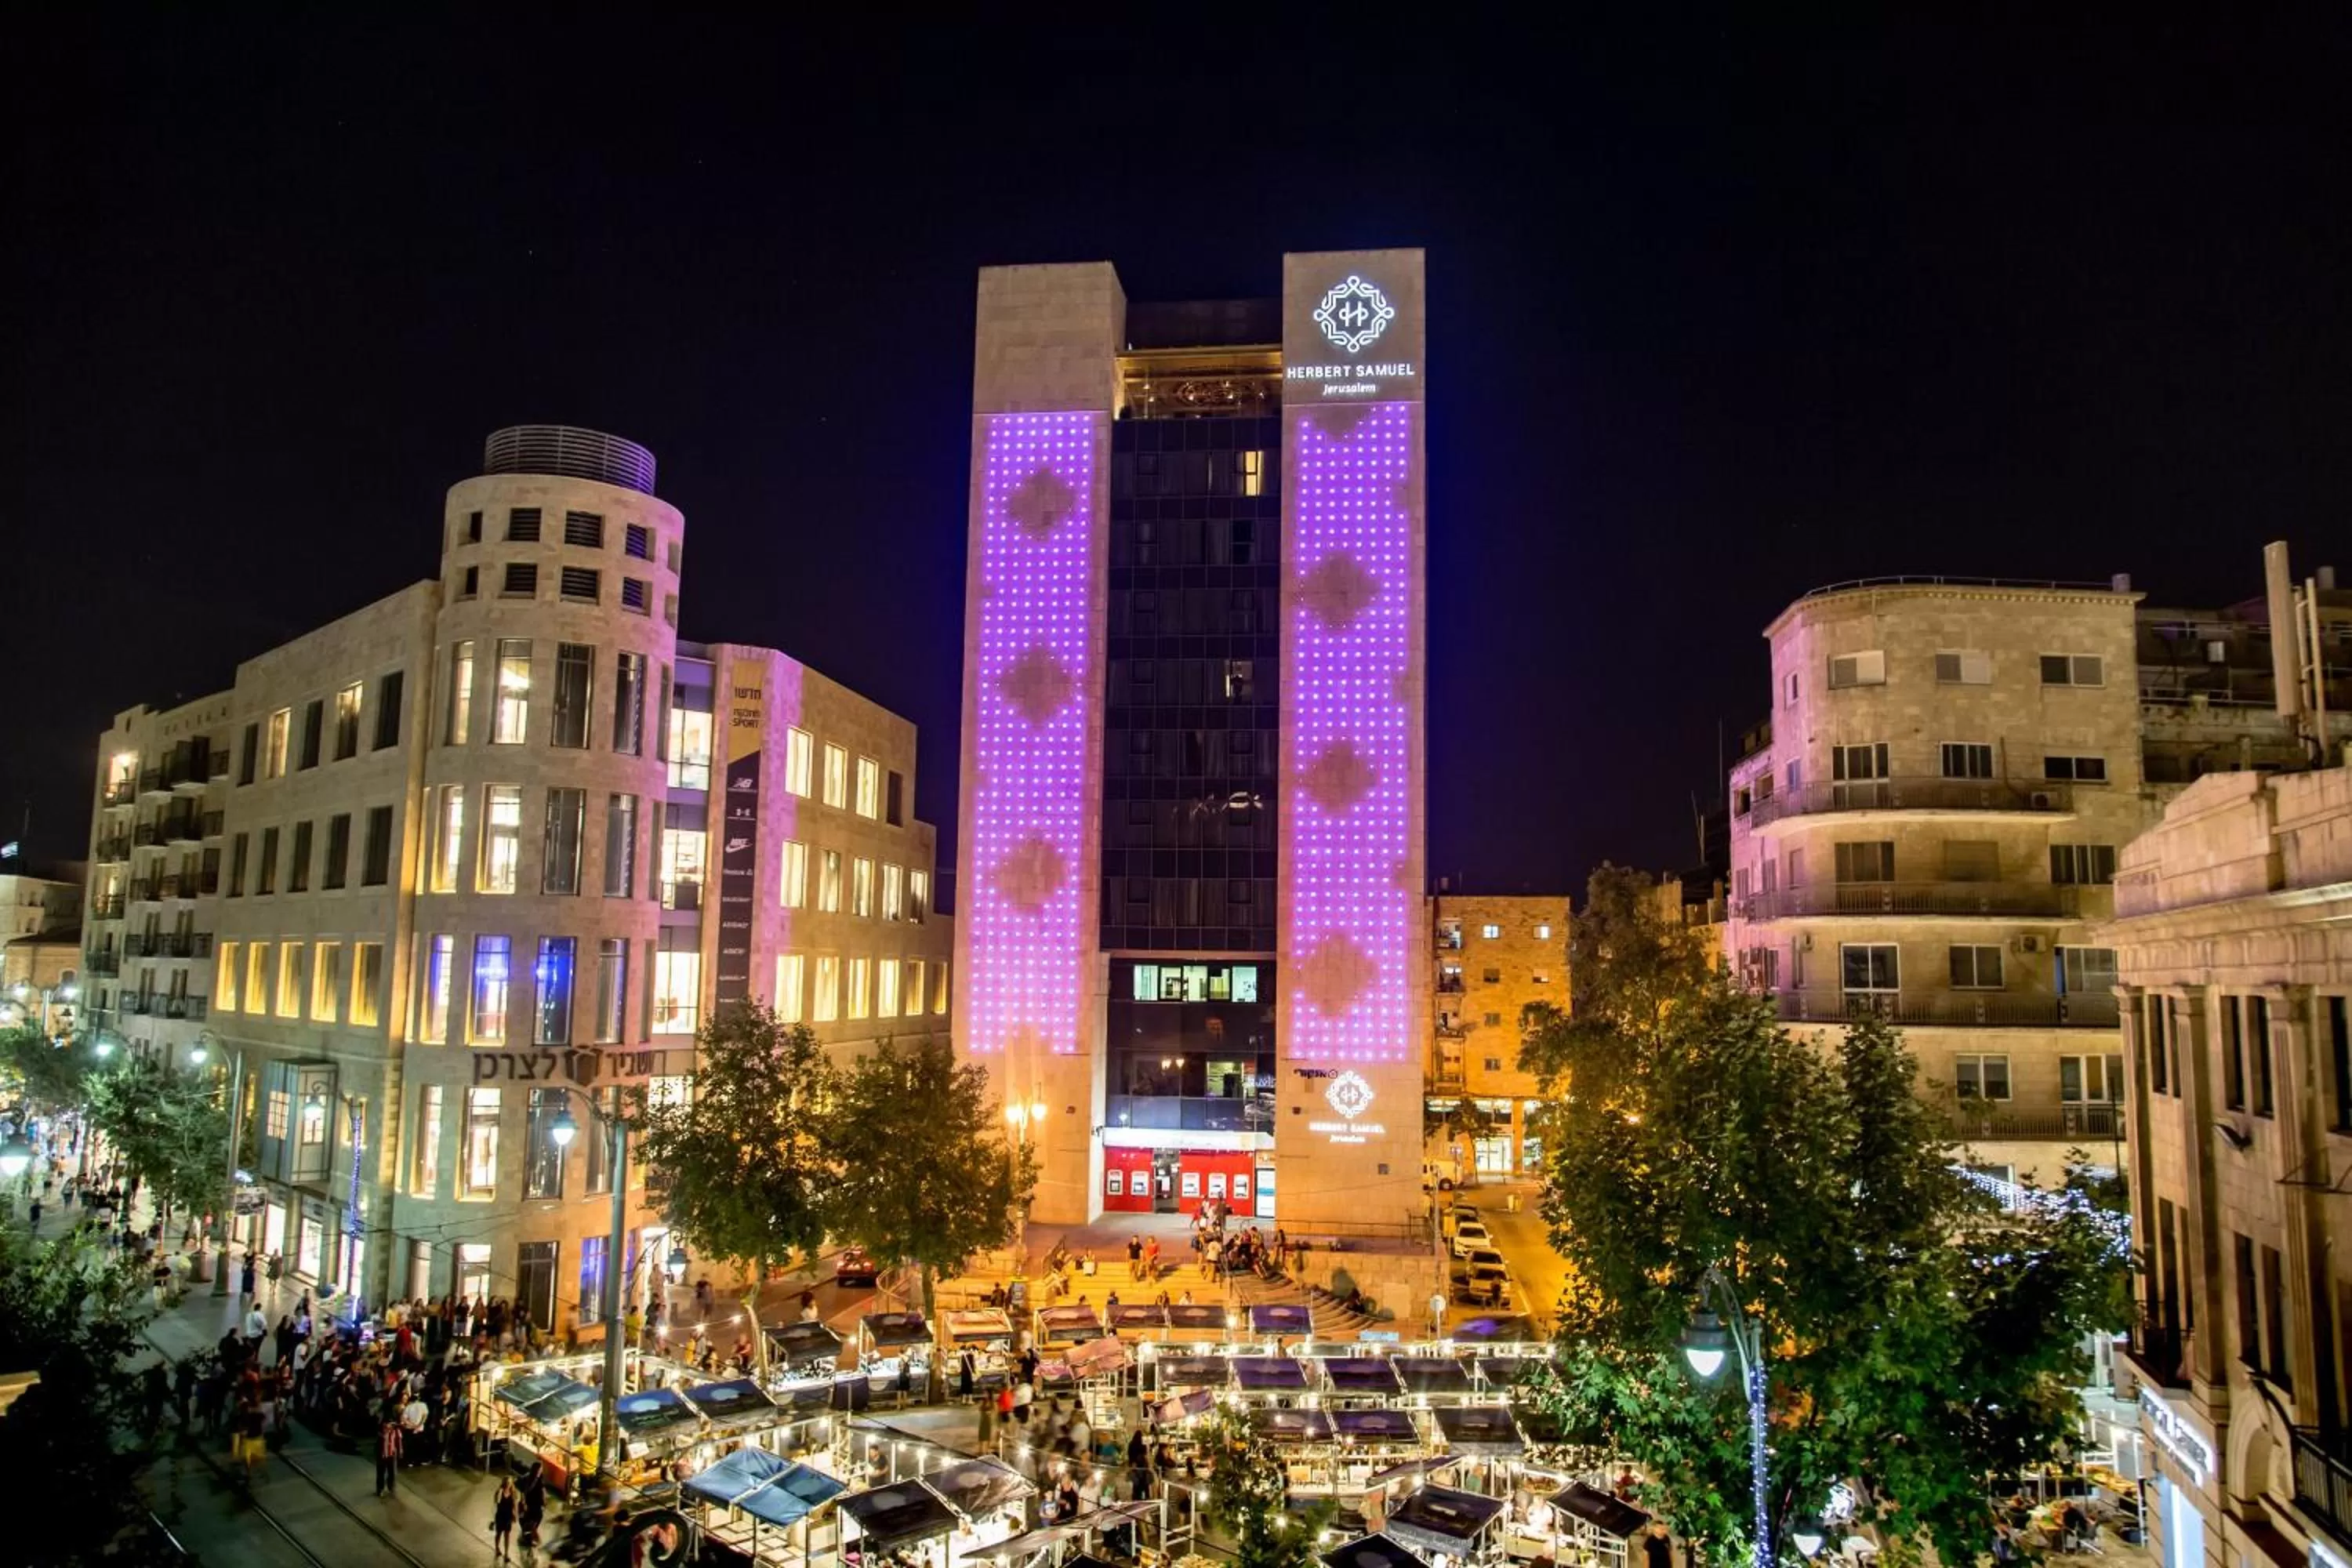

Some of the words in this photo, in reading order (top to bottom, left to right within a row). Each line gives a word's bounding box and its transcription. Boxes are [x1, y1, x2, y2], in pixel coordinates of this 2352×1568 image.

[1287, 365, 1351, 379] HERBERT
[1356, 363, 1415, 377] SAMUEL
[1322, 383, 1376, 395] Jerusalem
[472, 1046, 558, 1085] לצרכן
